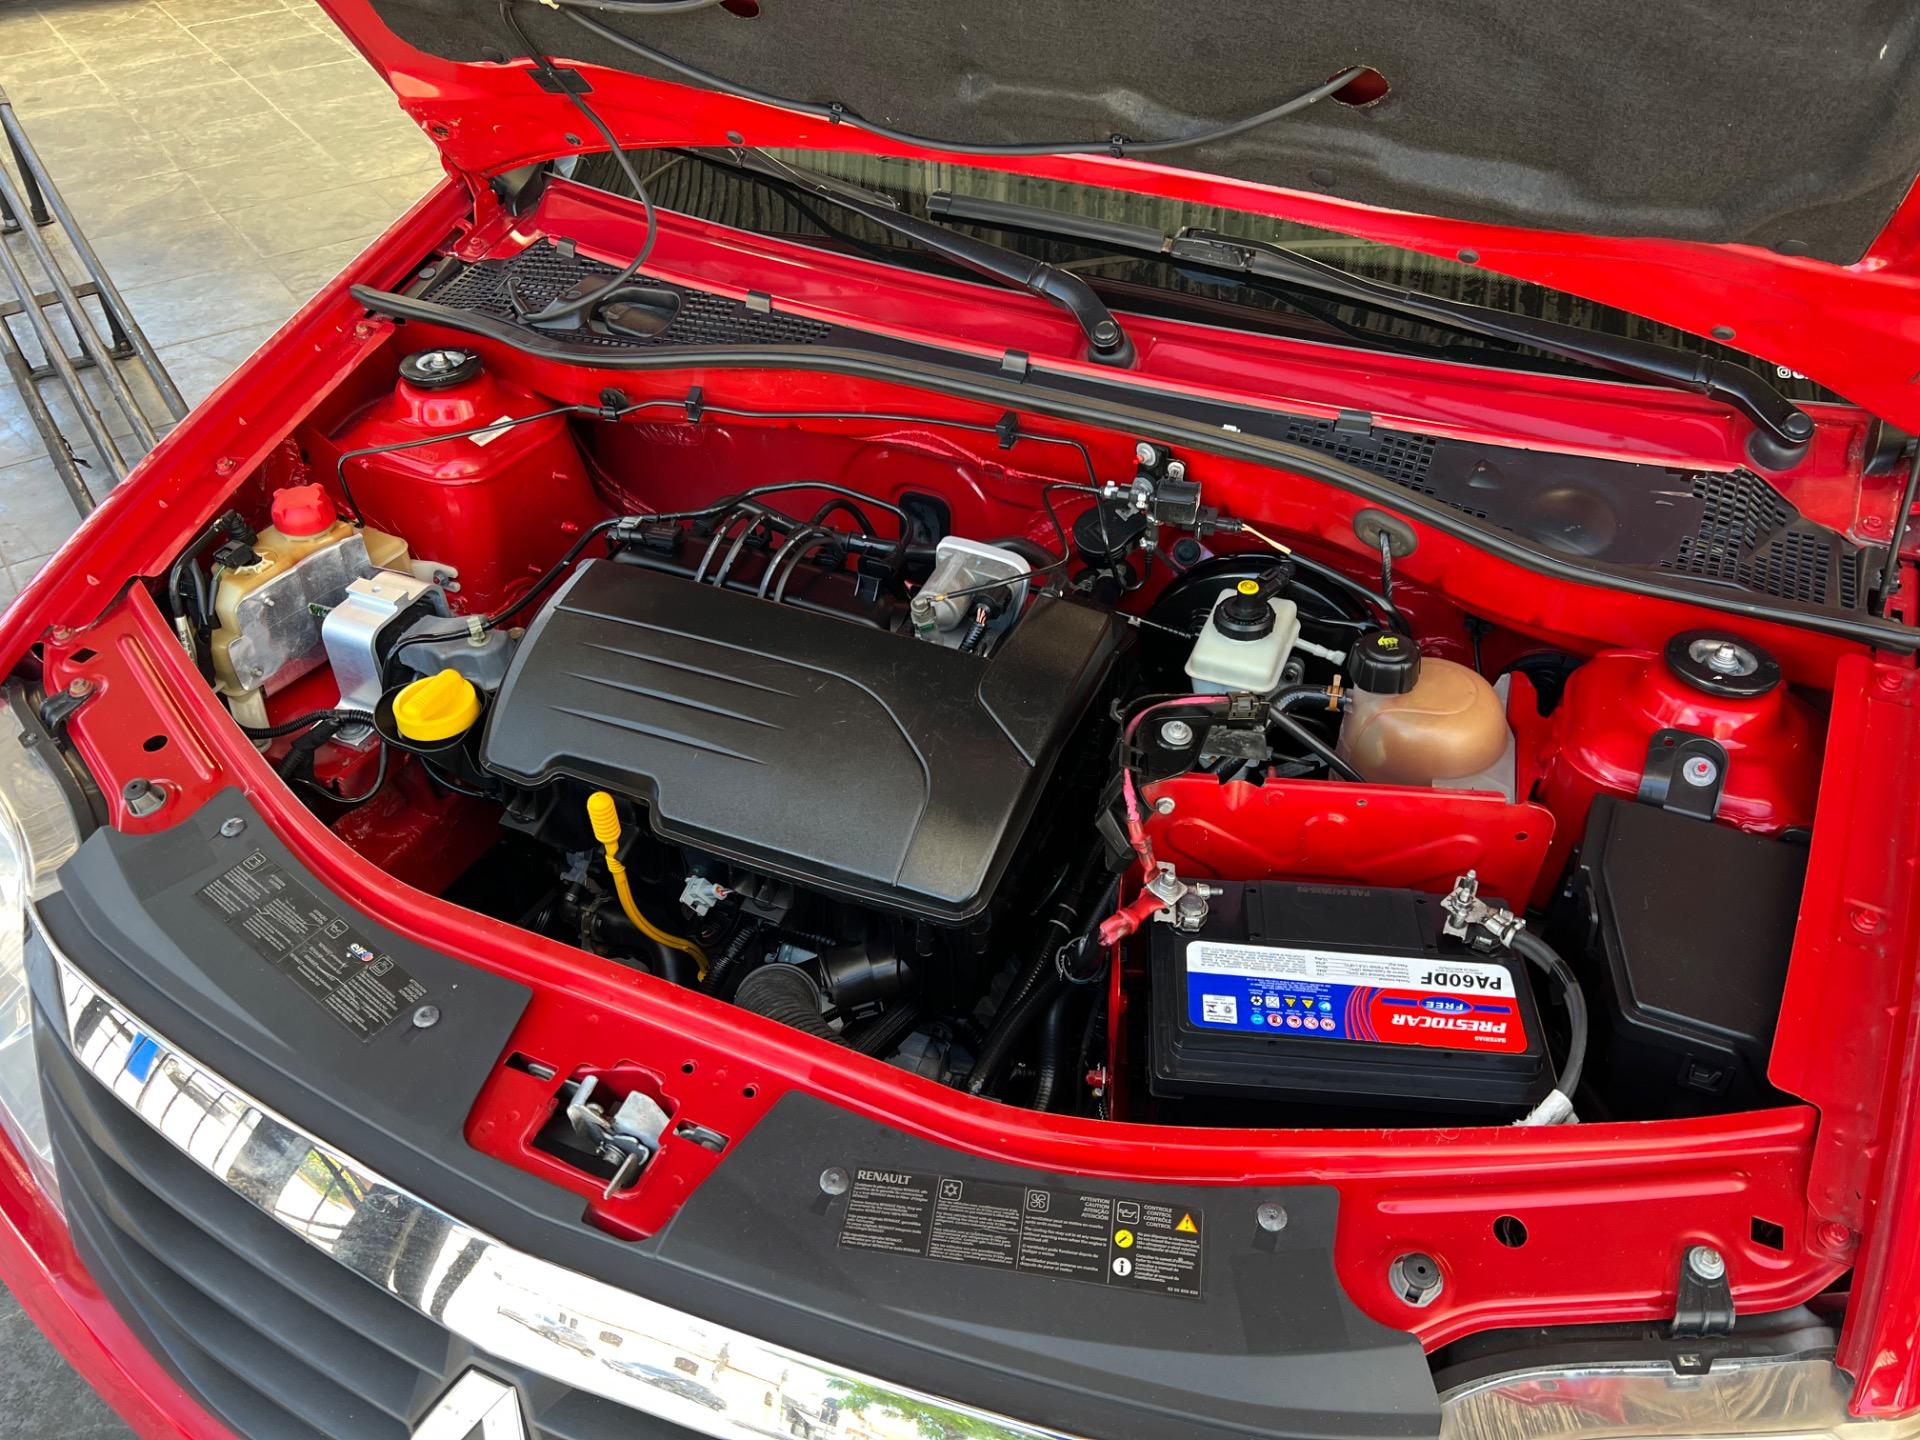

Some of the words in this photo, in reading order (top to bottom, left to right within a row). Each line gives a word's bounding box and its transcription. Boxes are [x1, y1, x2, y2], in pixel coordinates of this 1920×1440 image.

[1420, 972, 1502, 990] PA60DF
[1426, 1001, 1464, 1012] FREE
[1391, 1014, 1507, 1034] PRESTOCAR
[857, 1169, 912, 1185] RENAULT
